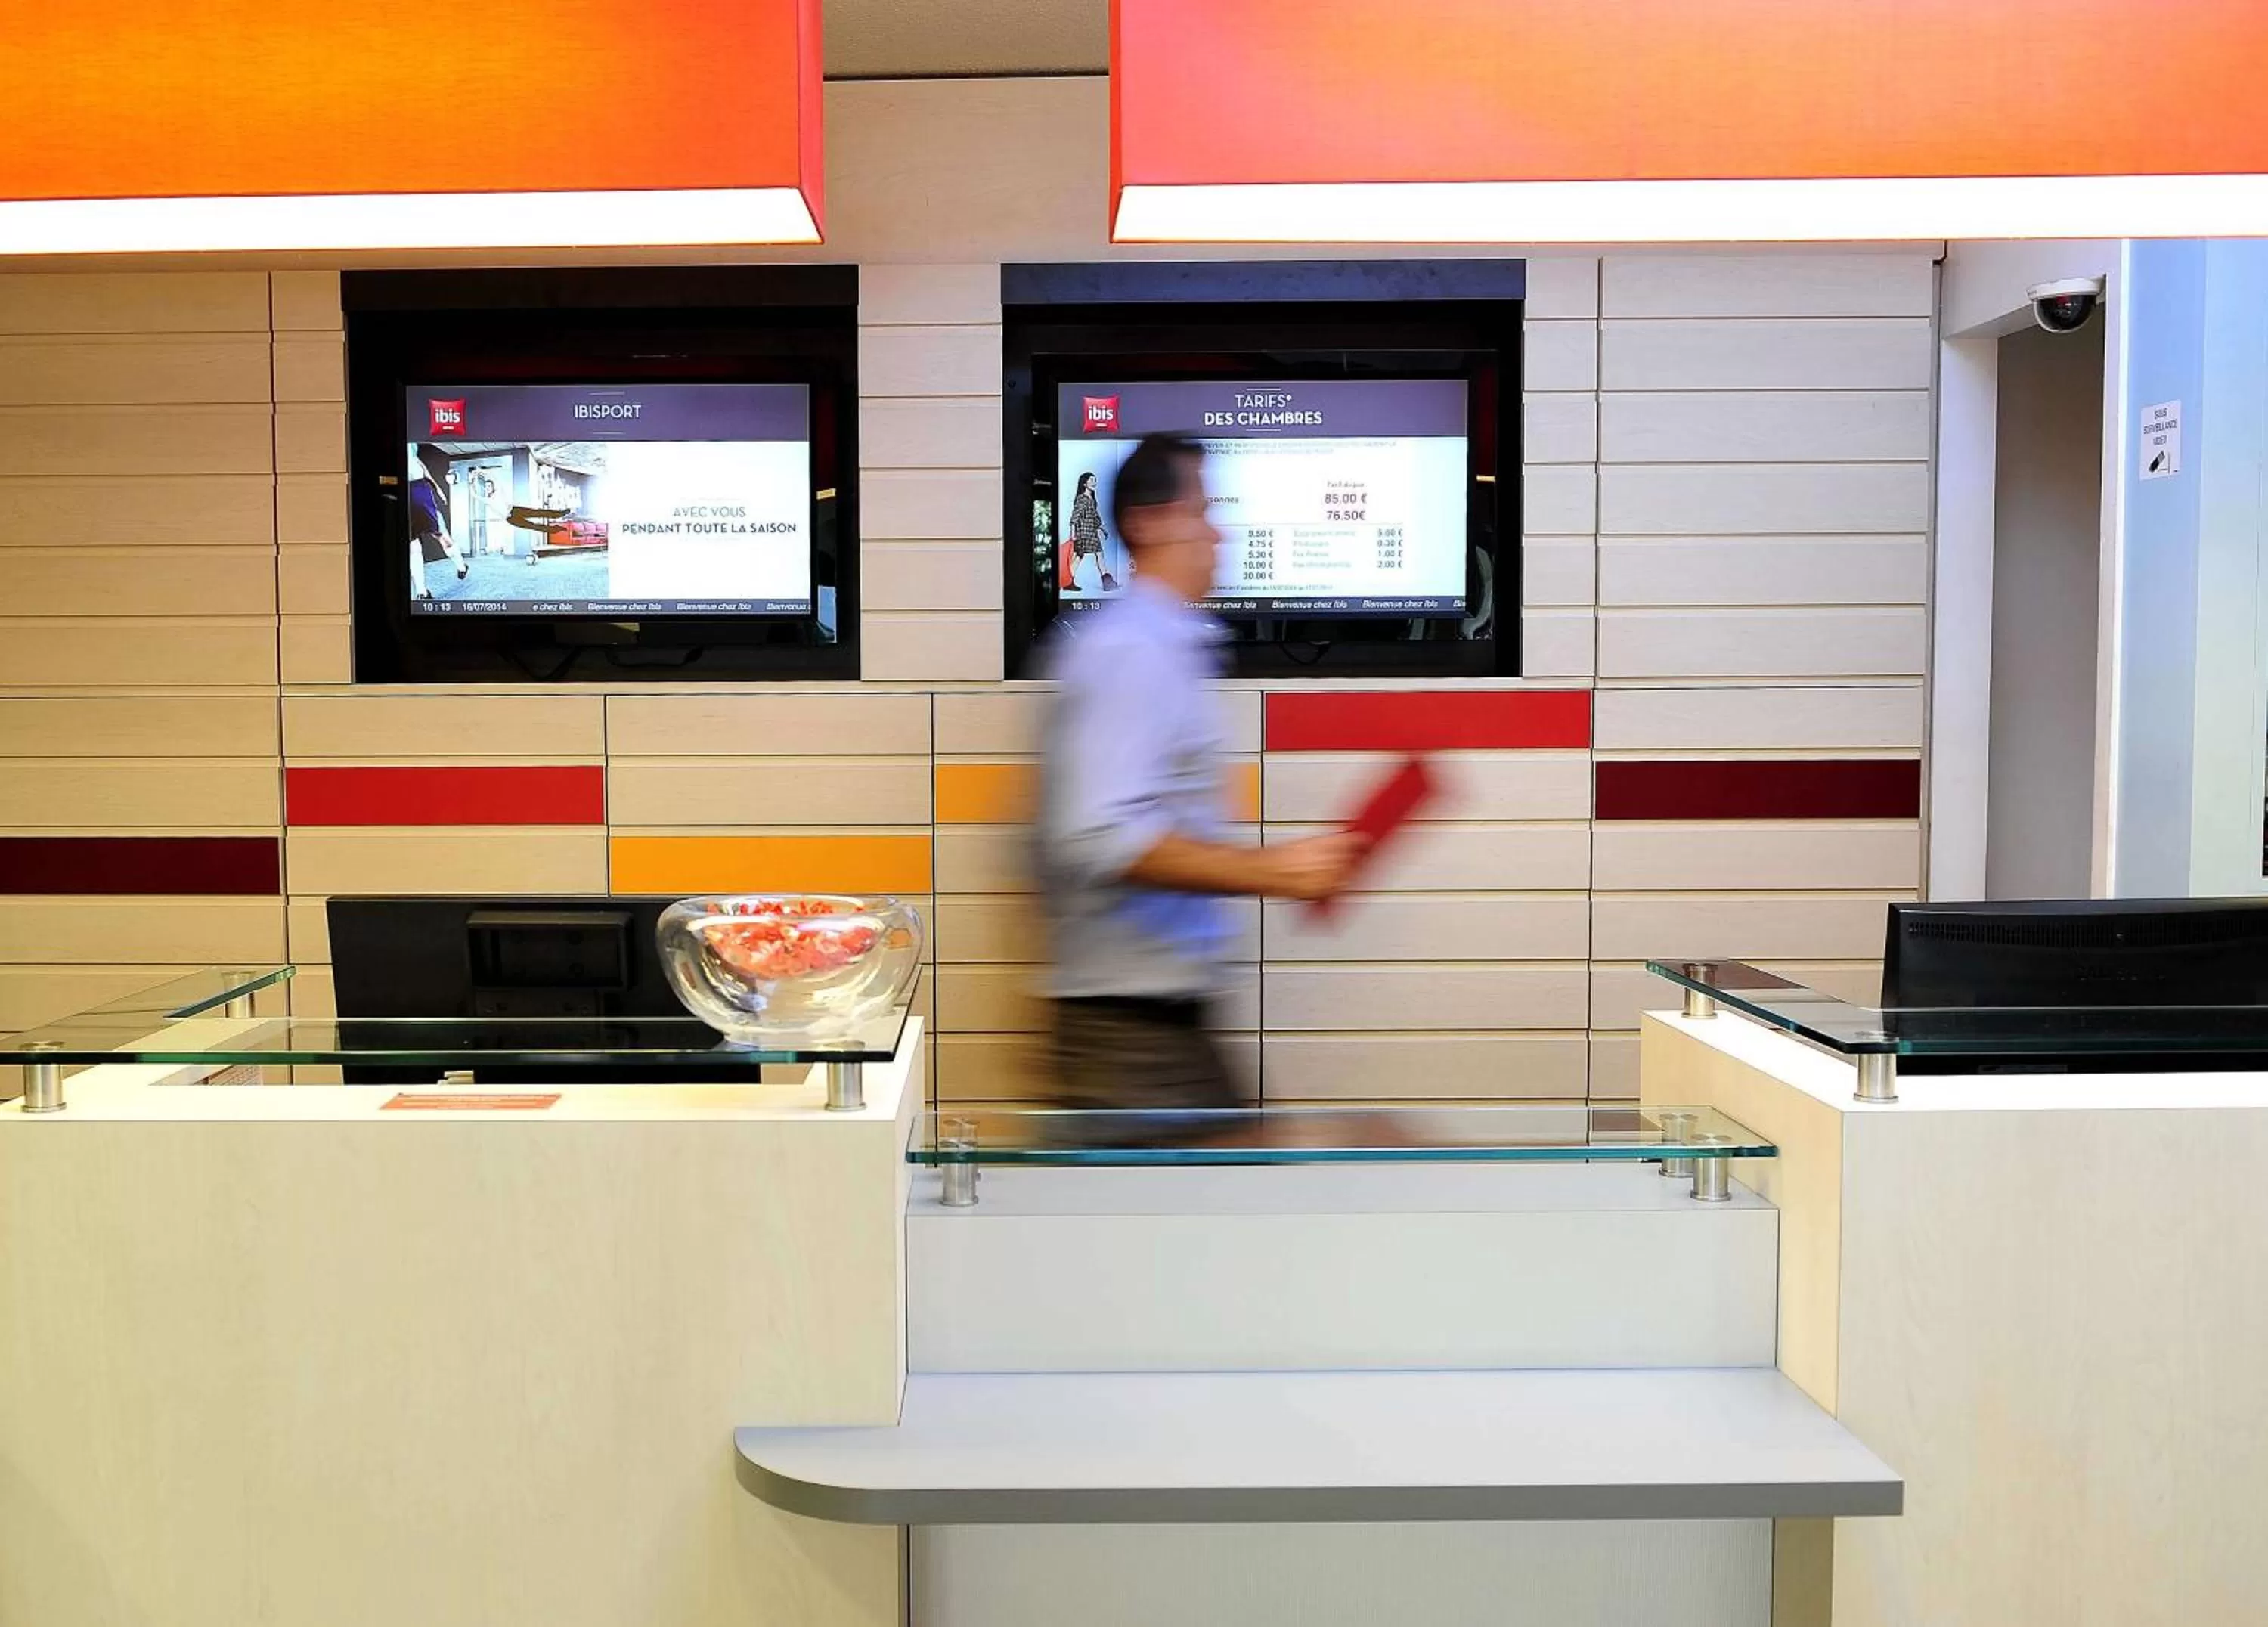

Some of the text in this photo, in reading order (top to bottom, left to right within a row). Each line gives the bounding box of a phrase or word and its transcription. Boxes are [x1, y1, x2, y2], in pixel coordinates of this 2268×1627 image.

[435, 408, 460, 423] ibis
[573, 404, 642, 418] IBISPORT
[1088, 404, 1114, 420] ibis
[1204, 411, 1323, 426] DES CHAMBRES
[1324, 493, 1357, 504] 85.00
[674, 506, 746, 518] AVEC VOUS
[622, 522, 797, 535] PENDANT TOUTE LA SAISON
